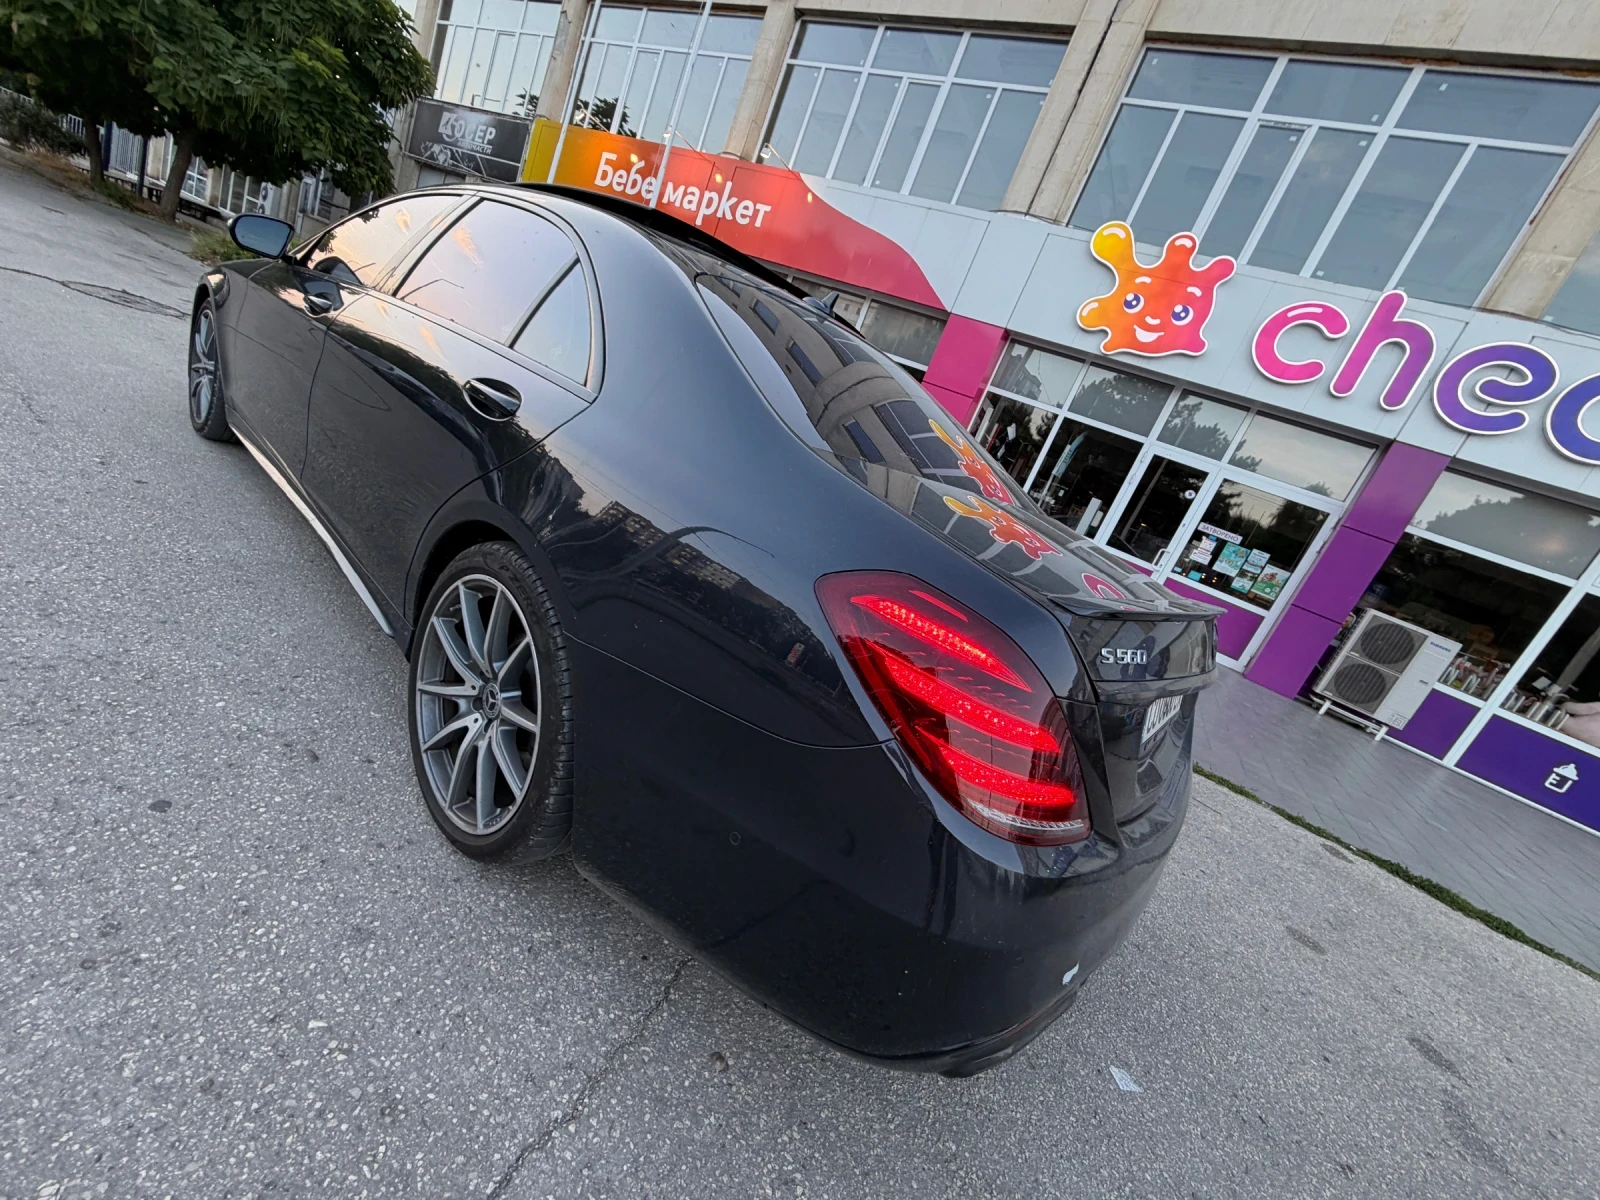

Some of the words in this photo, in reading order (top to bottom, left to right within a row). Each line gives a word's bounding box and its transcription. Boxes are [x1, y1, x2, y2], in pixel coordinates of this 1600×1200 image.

[594, 151, 658, 200] Бебе
[662, 180, 772, 228] маркет
[1201, 524, 1239, 542] ЗАТВОРЕНО
[1101, 647, 1114, 664] S
[1116, 648, 1147, 664] 560
